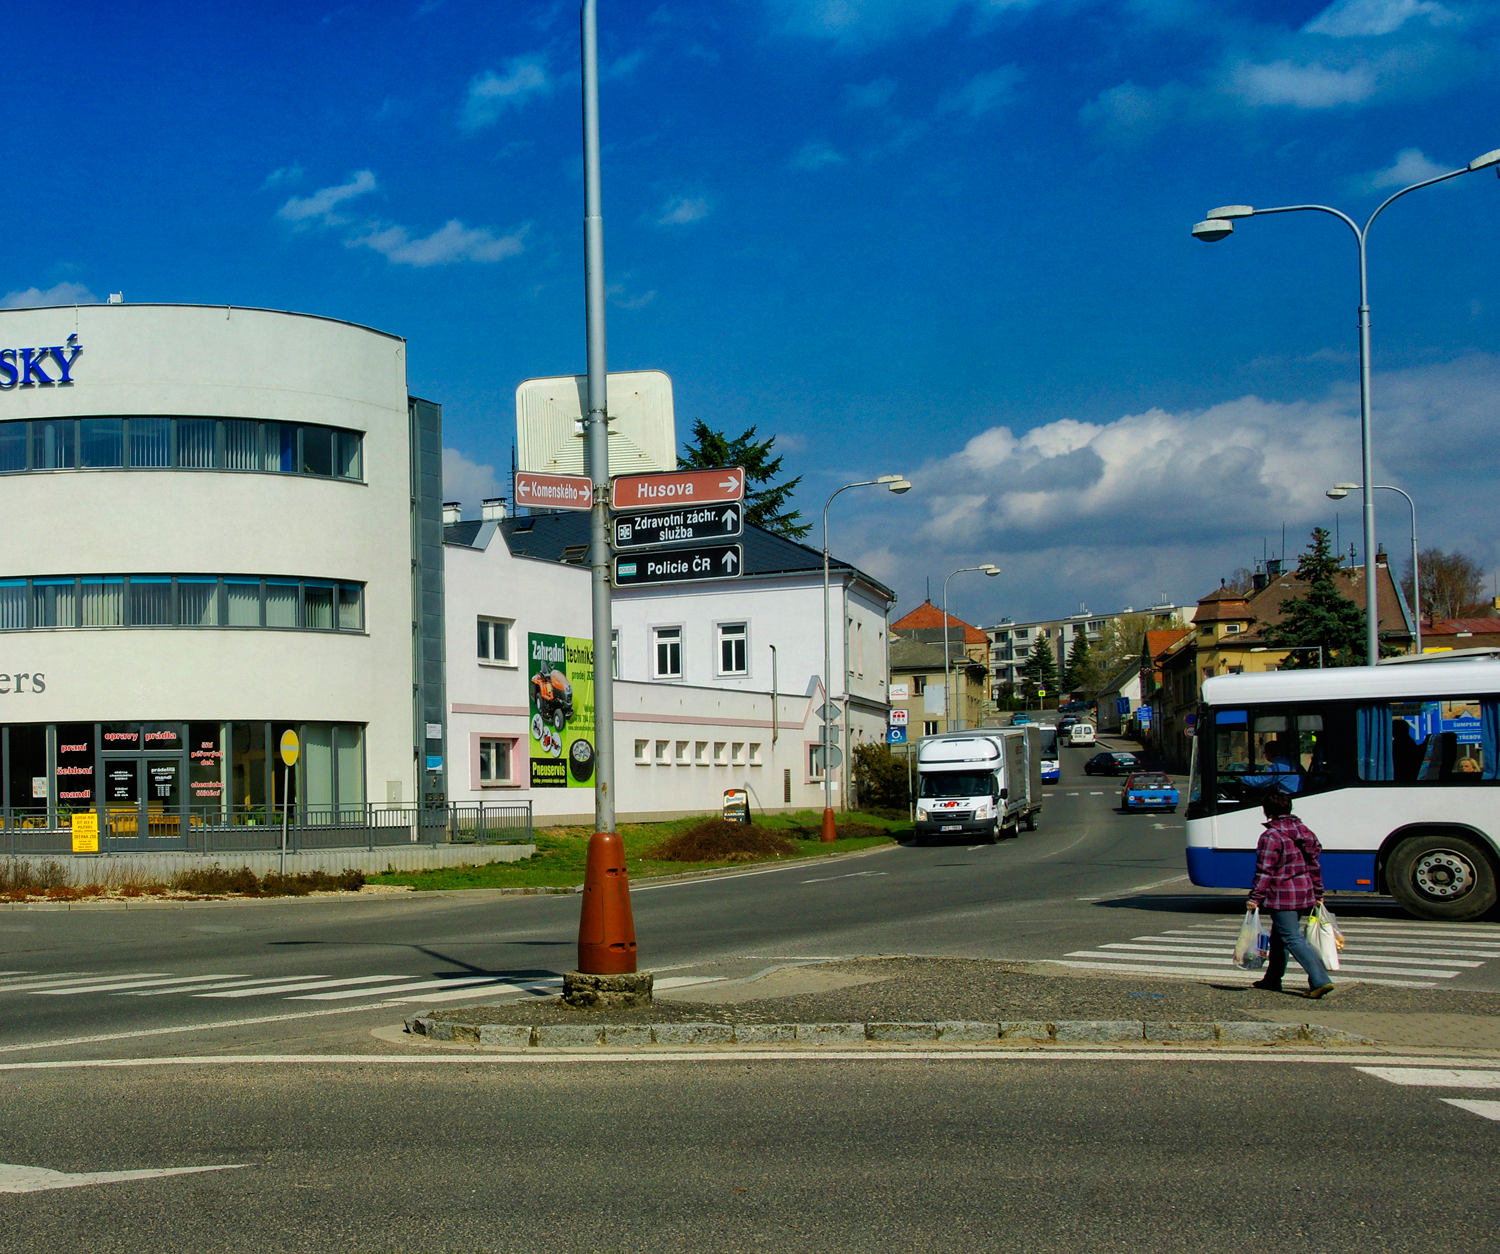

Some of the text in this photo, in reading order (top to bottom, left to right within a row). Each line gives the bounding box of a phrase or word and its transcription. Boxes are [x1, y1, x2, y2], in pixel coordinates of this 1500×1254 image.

[531, 481, 578, 500] Komenského
[637, 482, 694, 498] Husova
[634, 510, 719, 530] Zdravotní záchr.
[659, 527, 693, 541] služba
[647, 555, 711, 575] Policie ČR
[532, 640, 565, 663] Zahradní
[104, 731, 177, 742] opravy prádla
[60, 743, 88, 753] praní
[56, 766, 93, 776] žehlení
[532, 761, 566, 776] Pneuservis
[59, 790, 91, 799] mandl
